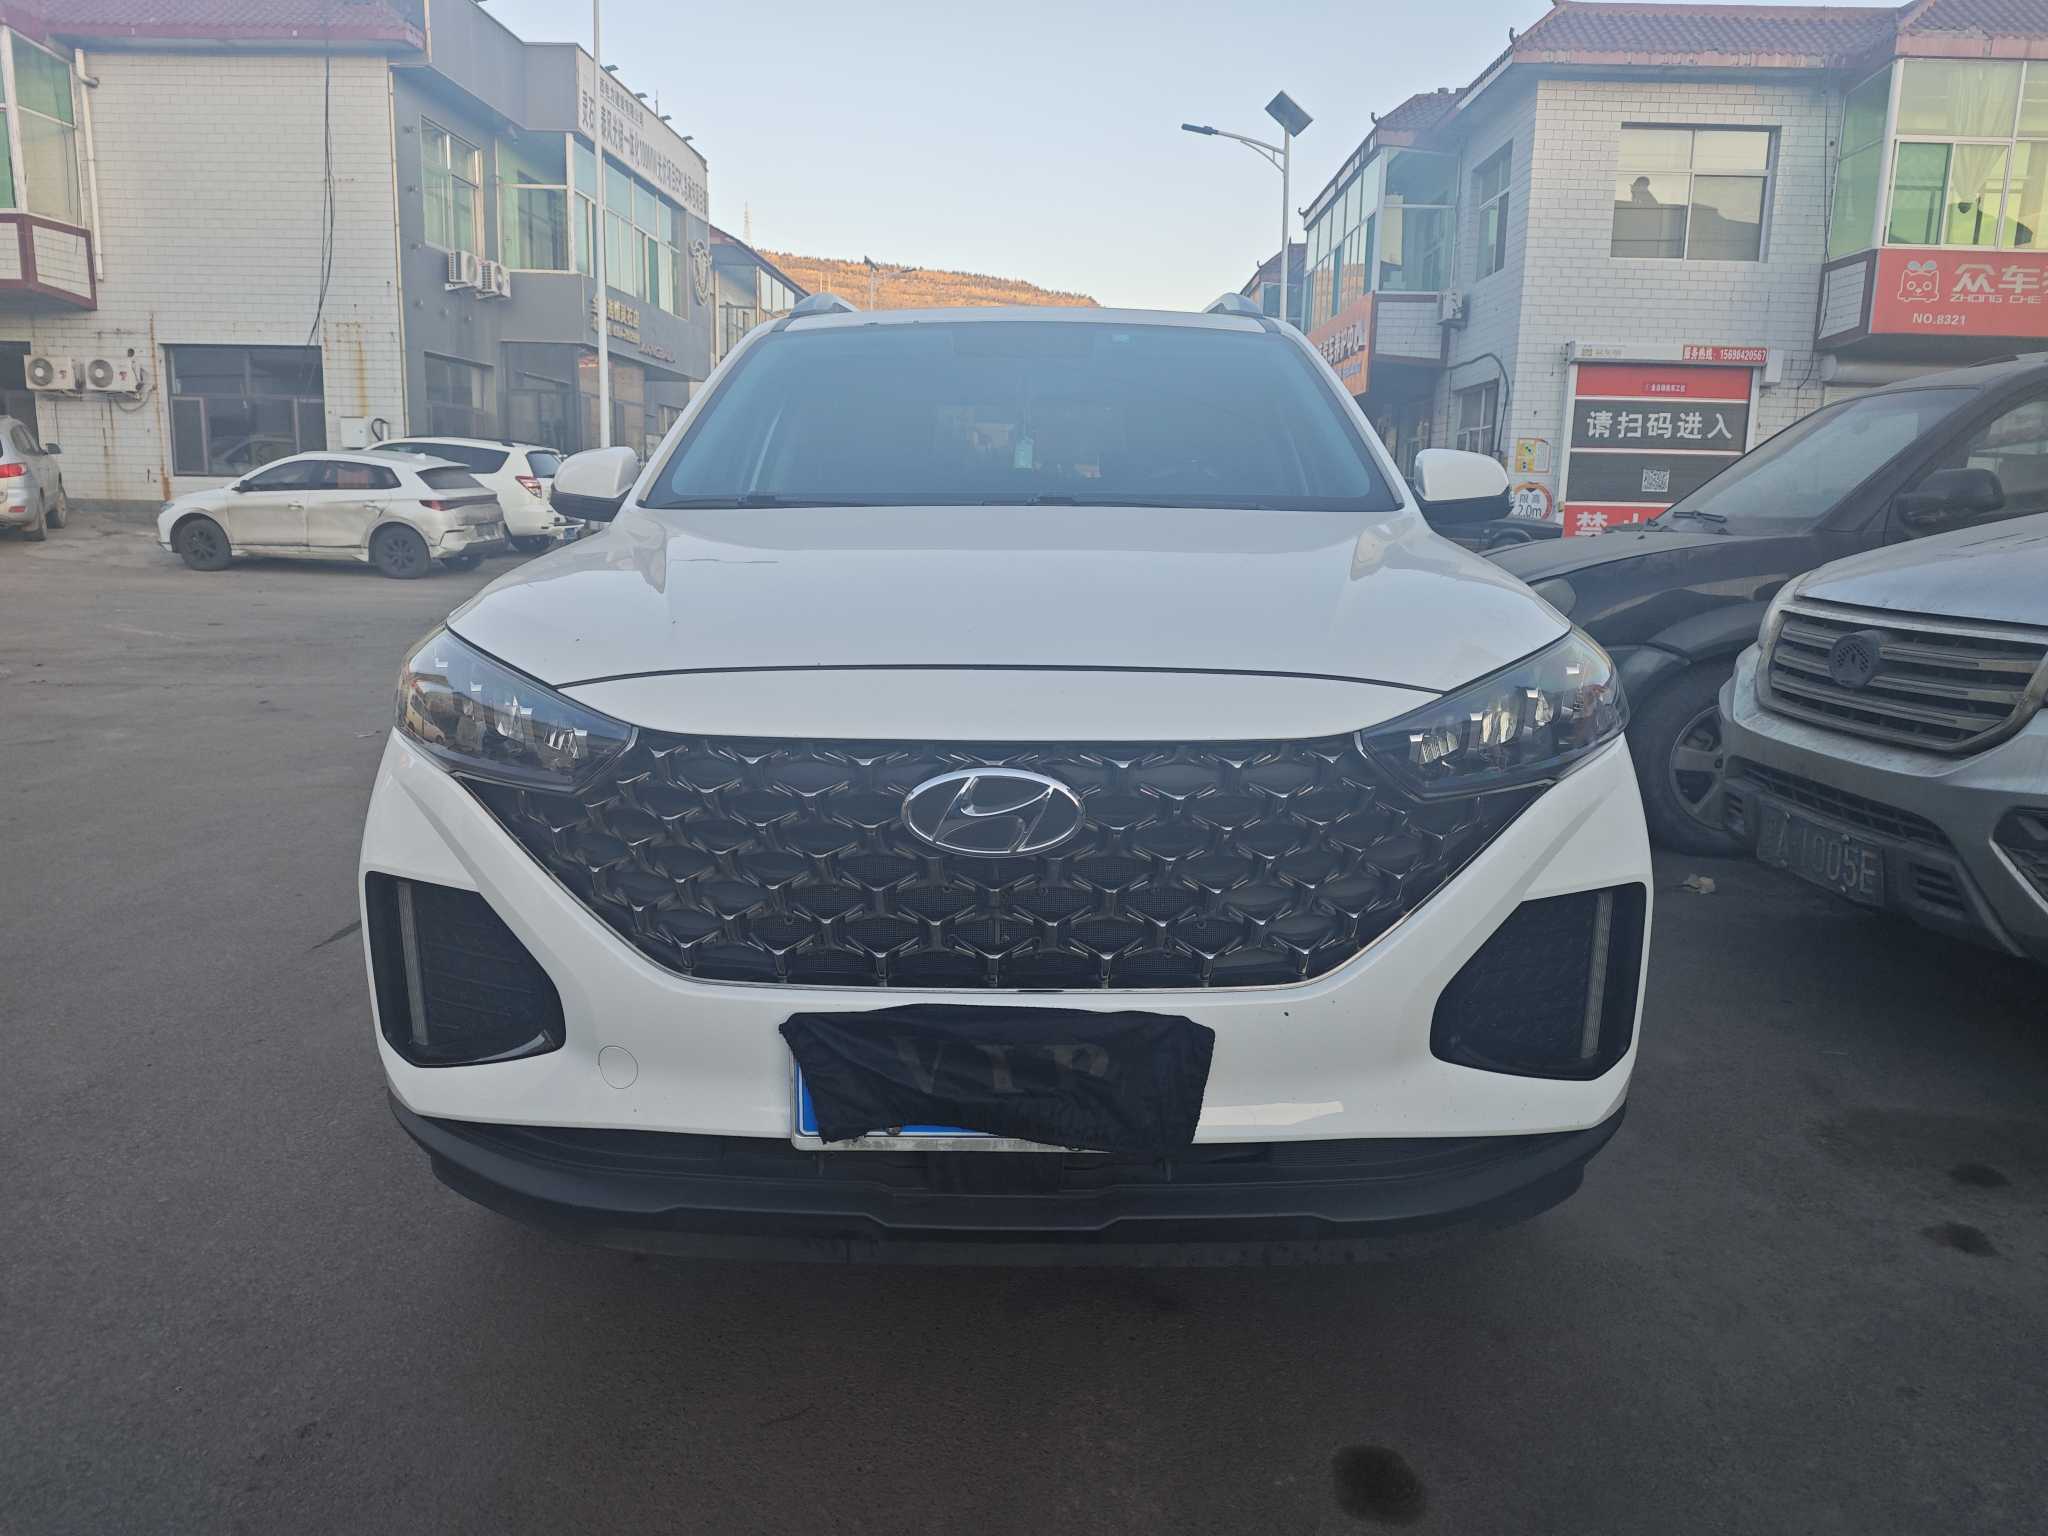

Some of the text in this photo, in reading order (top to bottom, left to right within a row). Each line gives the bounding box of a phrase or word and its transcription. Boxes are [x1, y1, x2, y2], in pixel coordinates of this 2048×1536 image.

[1952, 263, 2048, 294] 众车
[1950, 293, 2041, 304] ZHONG CHE
[1912, 312, 1967, 326] NO.8321
[1586, 410, 1733, 440] 请扫码进入
